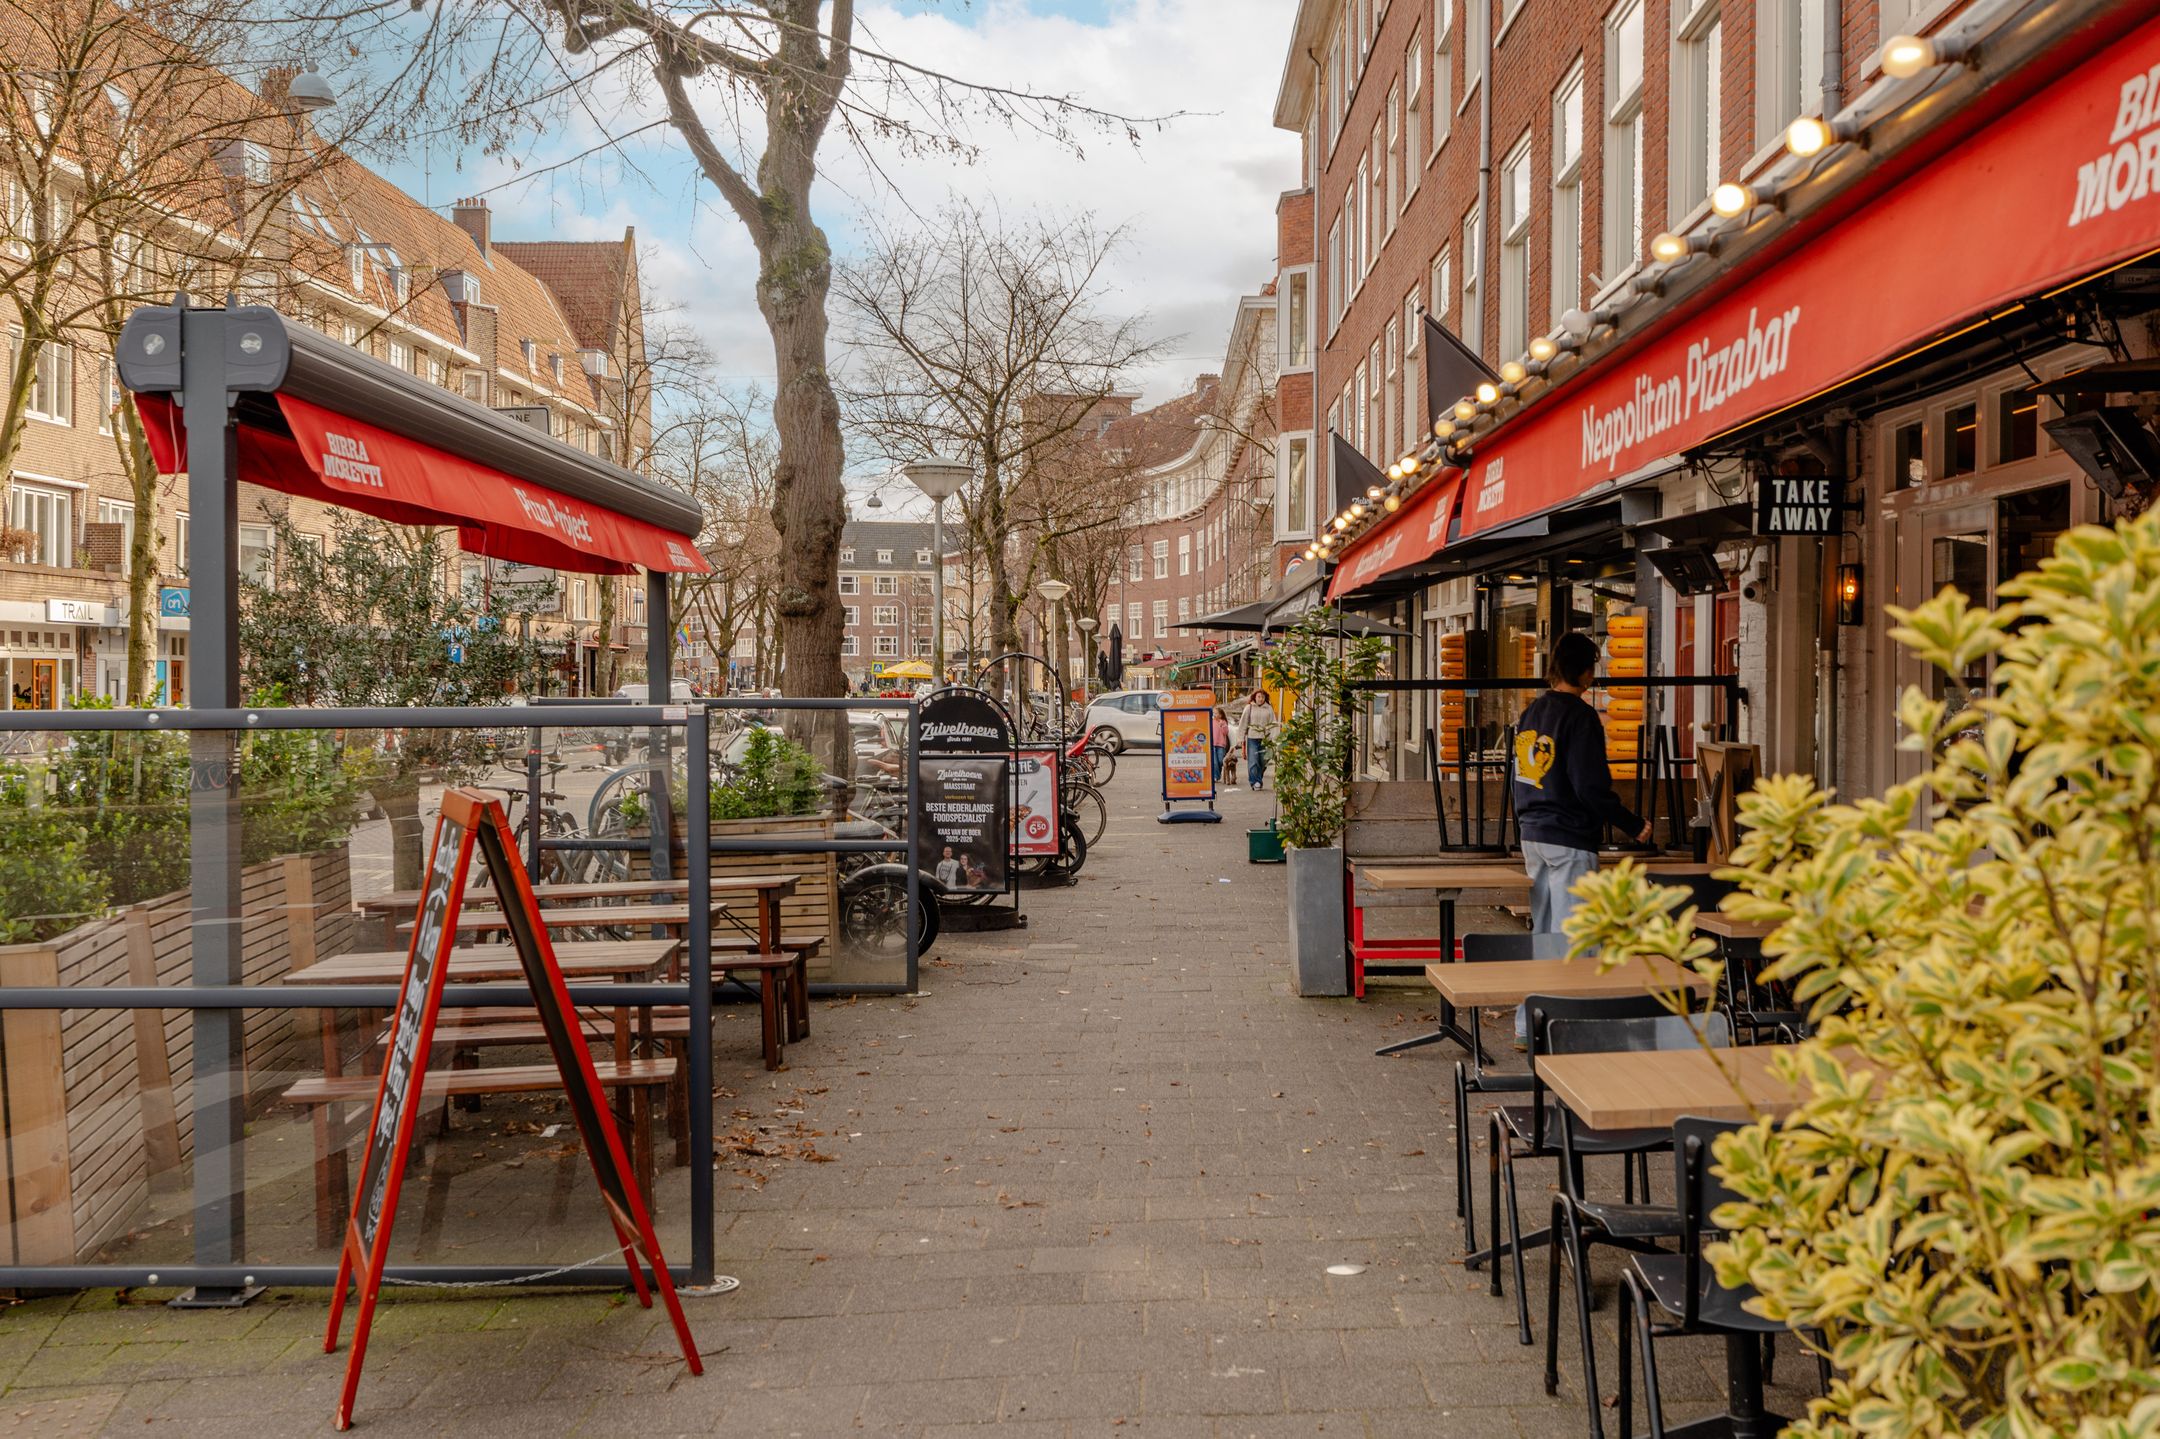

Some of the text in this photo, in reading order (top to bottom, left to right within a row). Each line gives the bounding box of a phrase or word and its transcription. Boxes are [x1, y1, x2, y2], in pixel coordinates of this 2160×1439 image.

[1582, 306, 1800, 472] Neapolitan Pizzabar
[325, 431, 369, 463] BIRRA
[322, 453, 384, 488] MORETTI
[1772, 480, 1830, 504] TAKE
[512, 487, 593, 547] Pizza Project
[1769, 507, 1832, 531] AWAY
[62, 602, 94, 620] TRAIL
[920, 722, 999, 742] Zuivelhoeve
[937, 769, 983, 781] Zuivelhoeve
[1009, 760, 1033, 773] ATIE
[943, 782, 976, 790] MAASSTRAAT
[925, 802, 994, 813] BESTE NEDERLANDSE
[933, 813, 986, 823] FOODSPECIALIST
